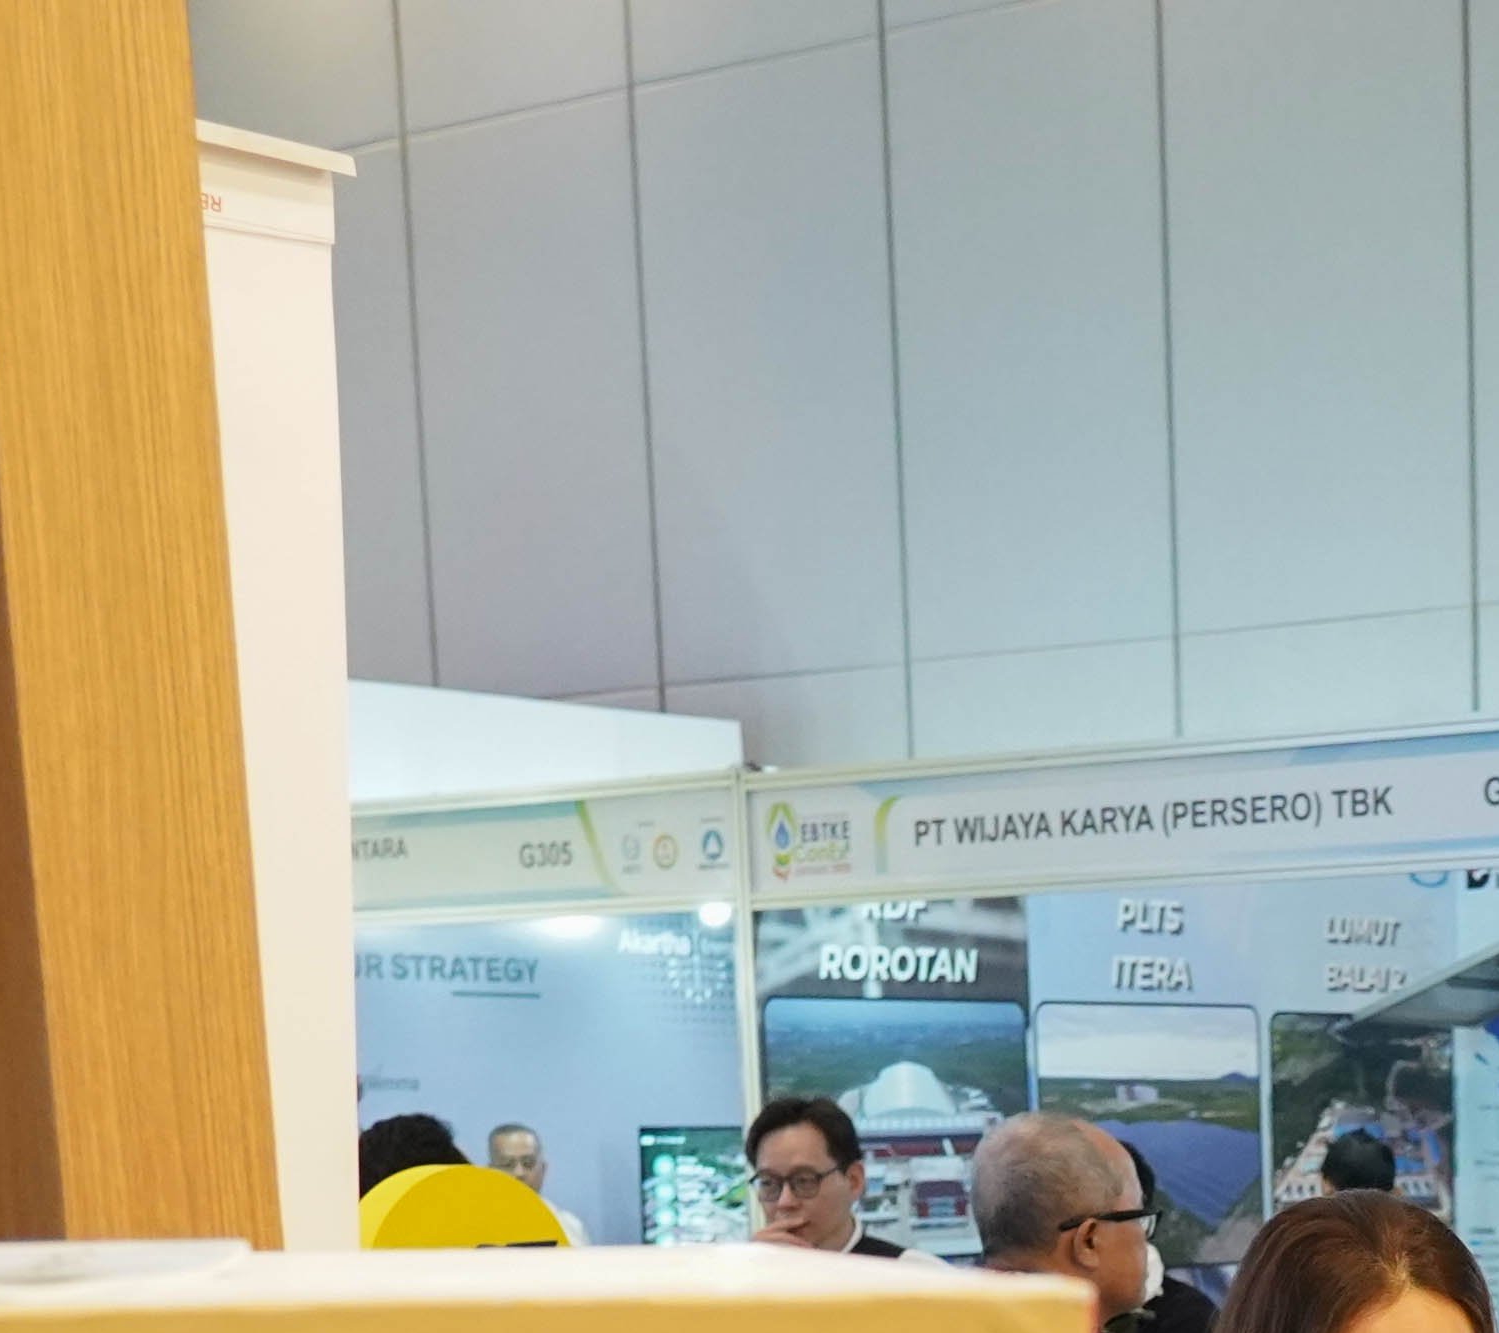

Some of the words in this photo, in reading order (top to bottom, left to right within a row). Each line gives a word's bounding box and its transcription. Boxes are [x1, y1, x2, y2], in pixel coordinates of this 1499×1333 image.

[915, 819, 945, 845] PT
[954, 812, 1052, 843] WIJAYA
[1061, 804, 1153, 836] KARYA
[1163, 792, 1321, 836] (PERSERO)
[1331, 786, 1391, 818] TBK
[519, 842, 574, 869] G305
[1117, 898, 1184, 935] PLTS
[391, 954, 539, 984] STRATEGY
[819, 944, 978, 984] ROROTAN
[1112, 956, 1193, 991] ITERA
